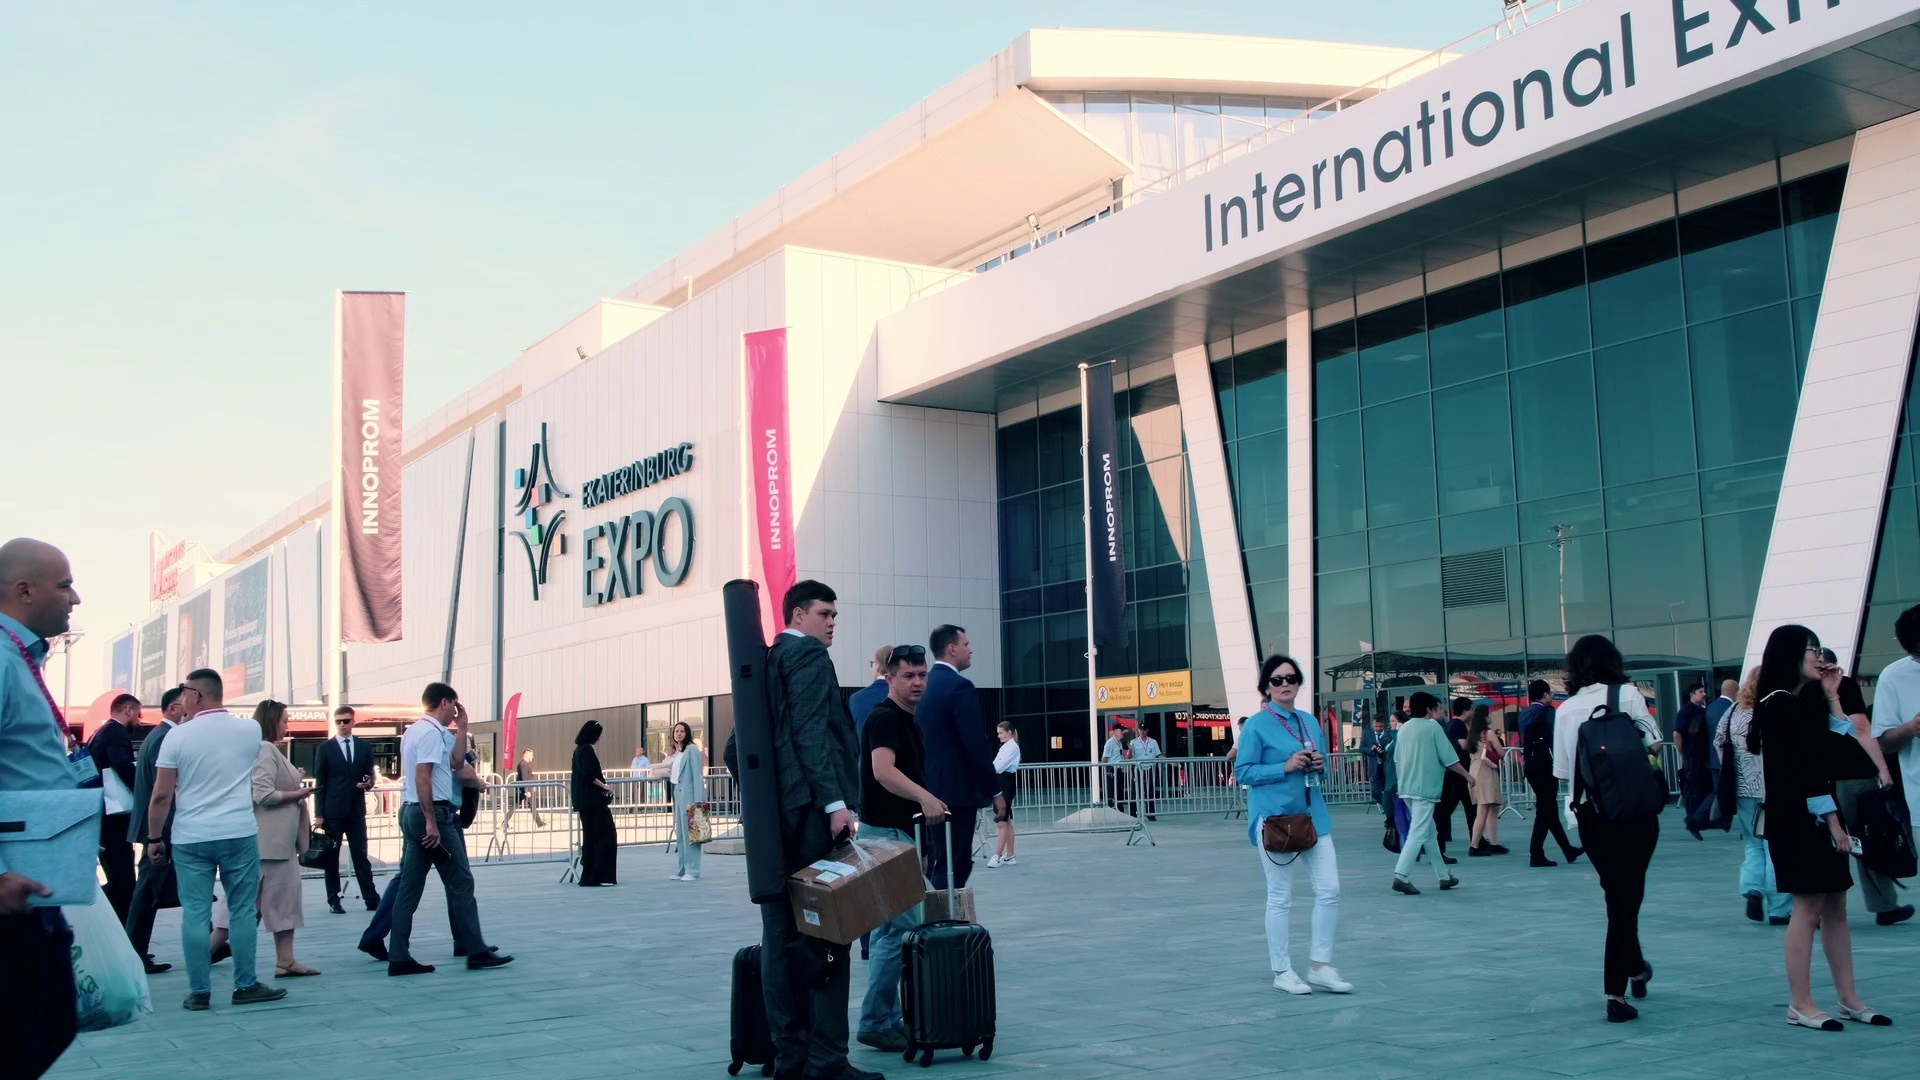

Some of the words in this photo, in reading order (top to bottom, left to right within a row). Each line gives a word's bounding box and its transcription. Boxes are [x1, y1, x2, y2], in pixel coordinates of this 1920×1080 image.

[1204, 12, 1636, 252] International
[1671, 0, 1841, 68] Ex
[362, 399, 380, 535] INNOPROM
[582, 442, 694, 509] EKATERINBURG
[765, 428, 781, 550] INNOPROM
[1102, 453, 1116, 562] INNOPROM
[583, 496, 696, 608] EXPO
